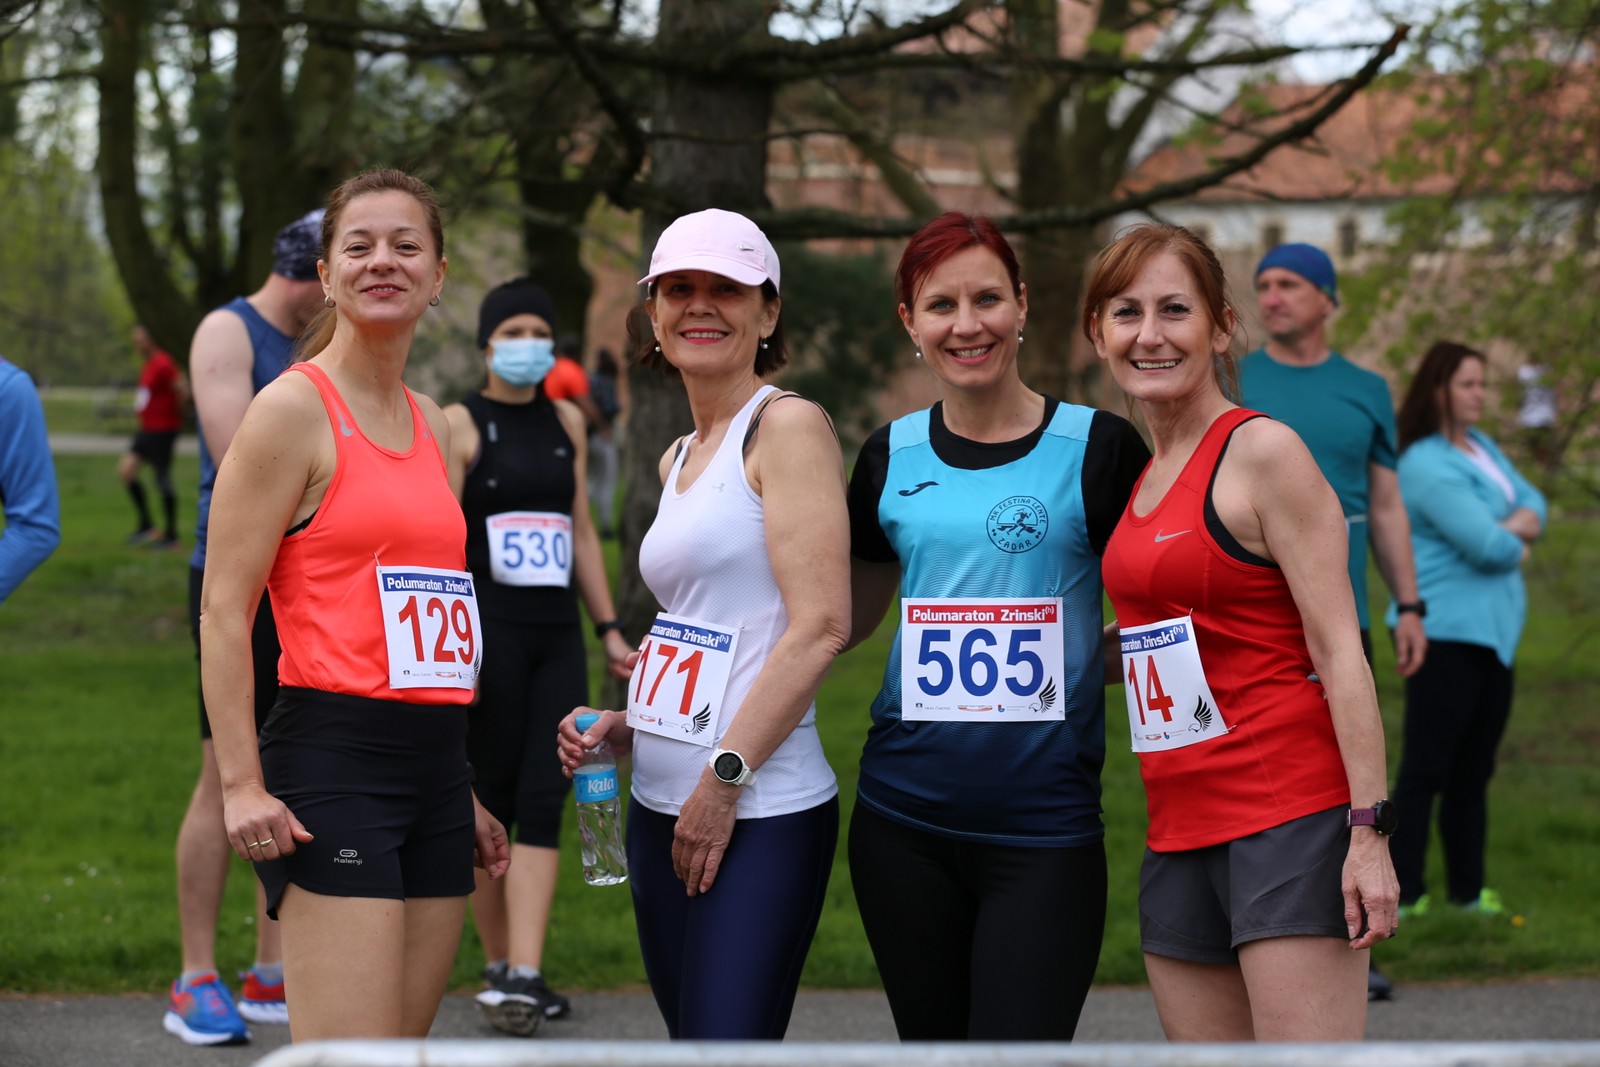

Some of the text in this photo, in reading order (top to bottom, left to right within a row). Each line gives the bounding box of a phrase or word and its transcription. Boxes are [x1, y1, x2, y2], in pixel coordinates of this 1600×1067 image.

[989, 498, 1047, 524] MK FESTINA LENTE
[503, 531, 568, 569] 530
[997, 537, 1032, 551] ZADAR
[386, 576, 443, 591] Polumaraton
[912, 608, 994, 622] Polumaraton
[398, 595, 474, 665] 129
[917, 628, 1044, 697] 565
[635, 639, 704, 716] 171
[1128, 654, 1174, 726] 14
[588, 777, 615, 794] Kala
[333, 857, 363, 866] Kalenji
